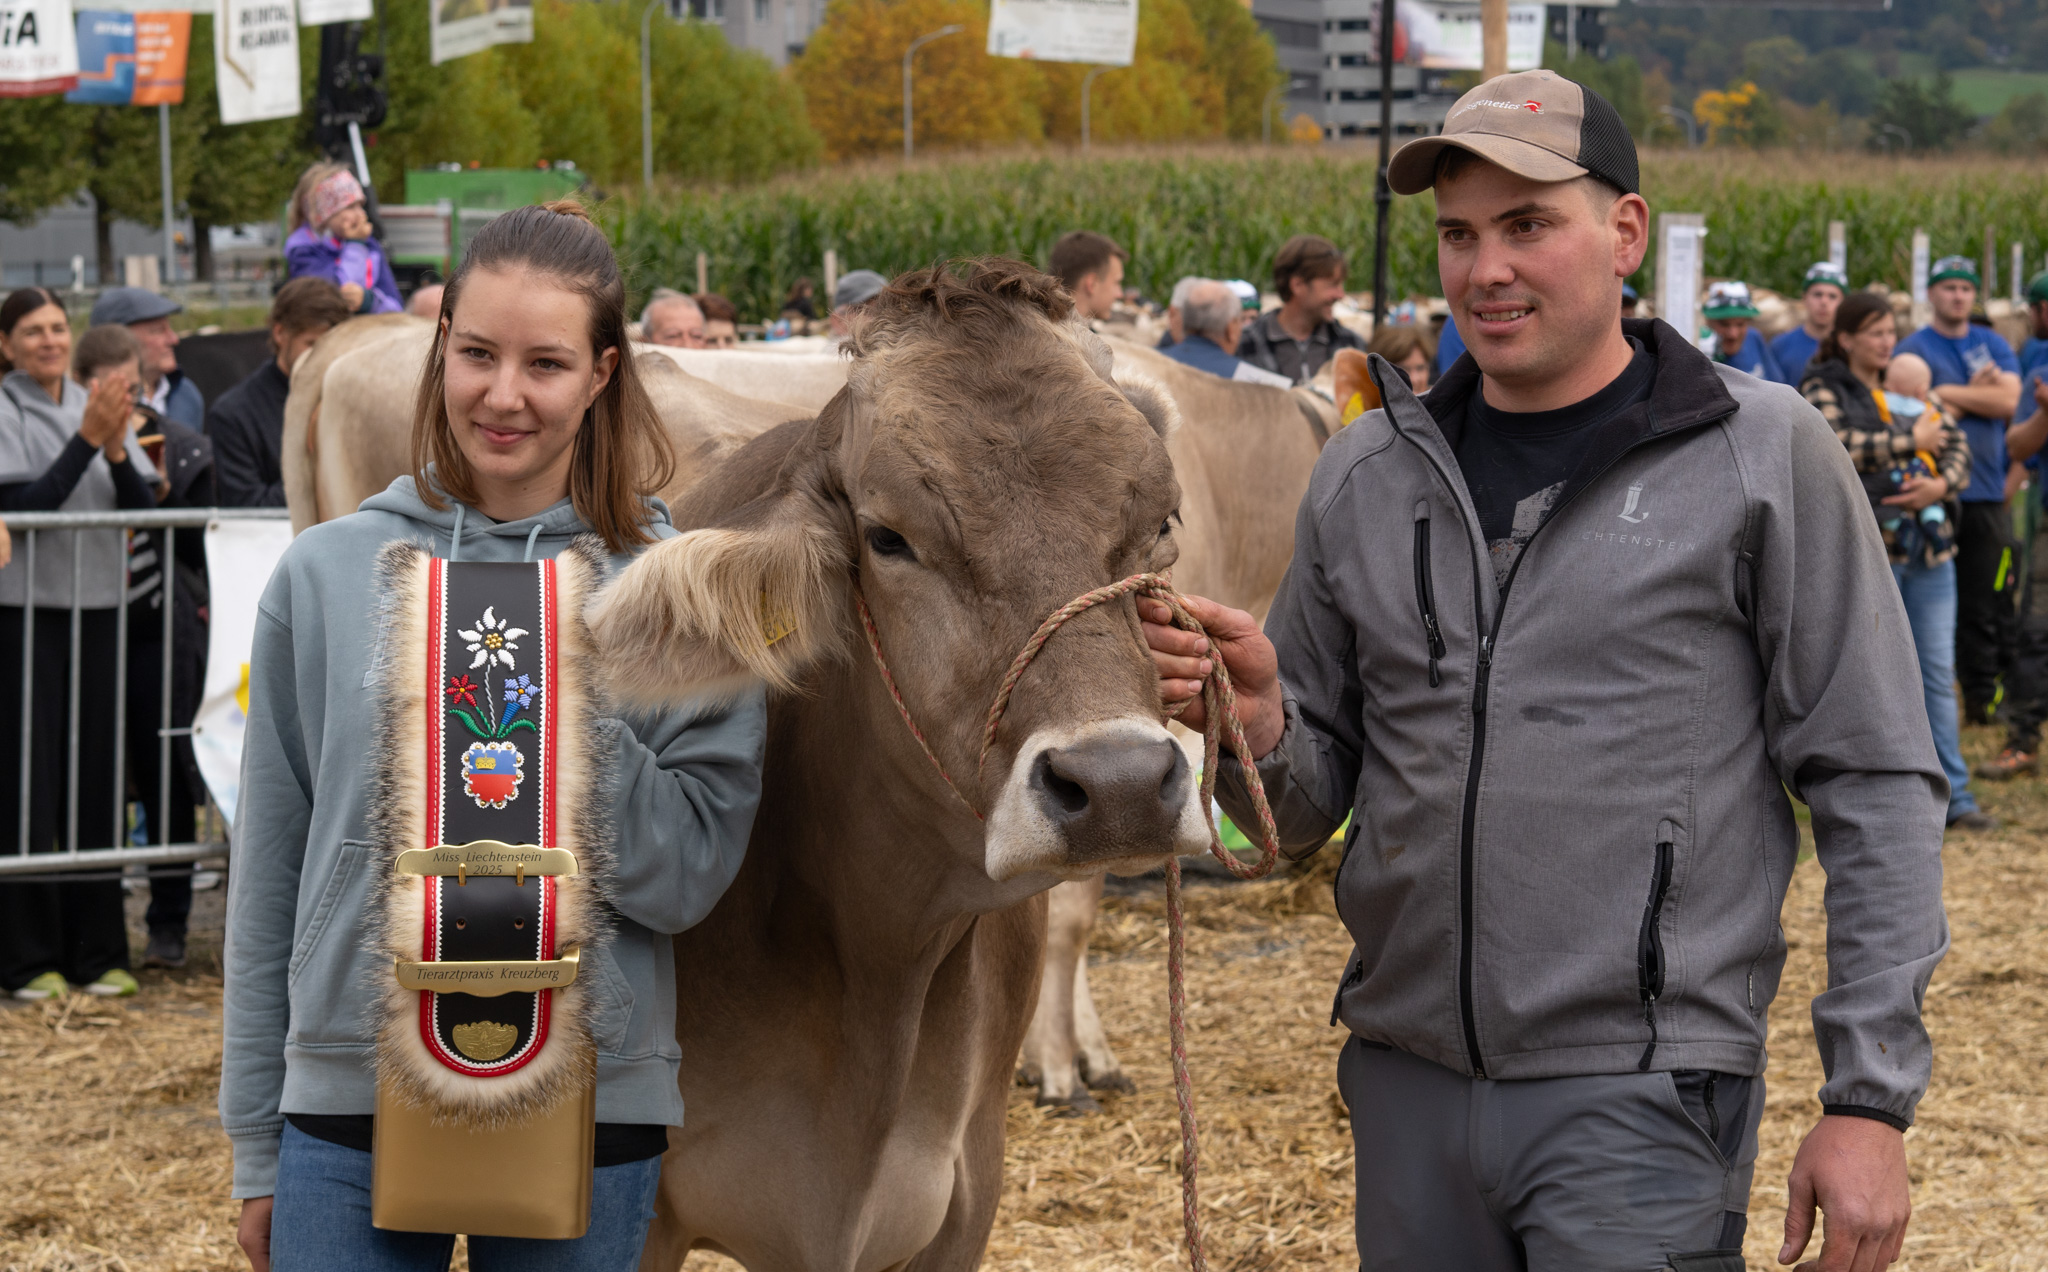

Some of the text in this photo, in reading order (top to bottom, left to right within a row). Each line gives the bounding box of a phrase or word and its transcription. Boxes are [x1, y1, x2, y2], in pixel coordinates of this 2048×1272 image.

[433, 851, 542, 863] Miss Liechtenstein
[473, 864, 503, 875] 2025
[417, 967, 560, 982] Tierarztpraxis Kreuzberg
